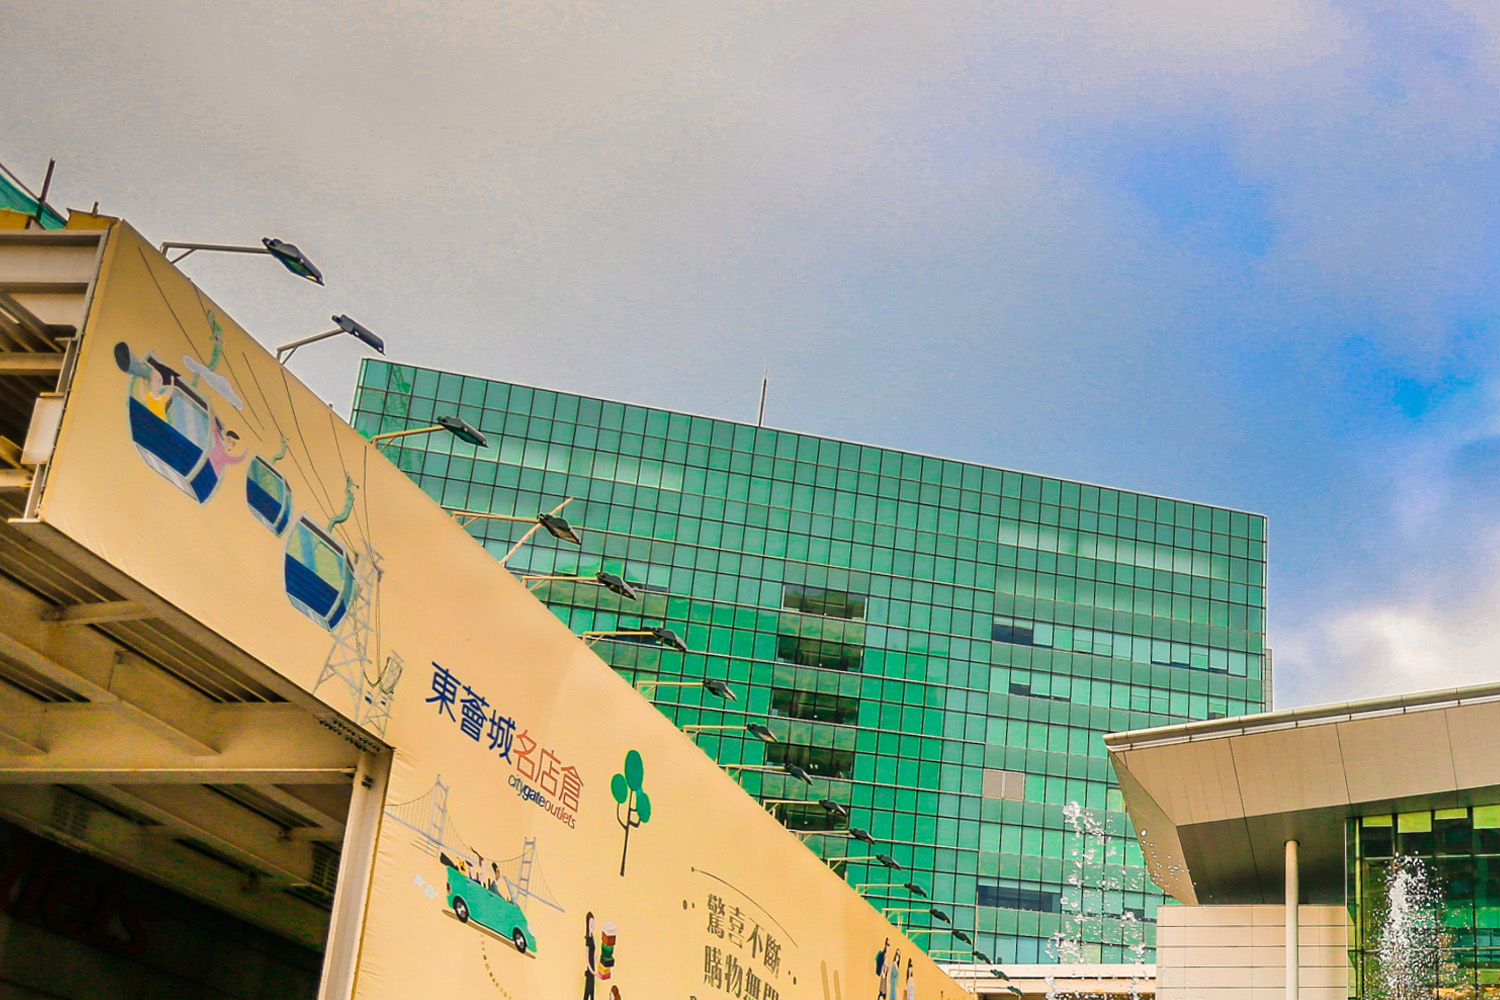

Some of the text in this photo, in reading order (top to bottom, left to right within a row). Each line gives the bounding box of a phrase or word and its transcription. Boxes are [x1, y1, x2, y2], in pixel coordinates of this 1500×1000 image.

[425, 661, 584, 813] 東薈城名店倉
[706, 893, 782, 979] 驚喜不斷
